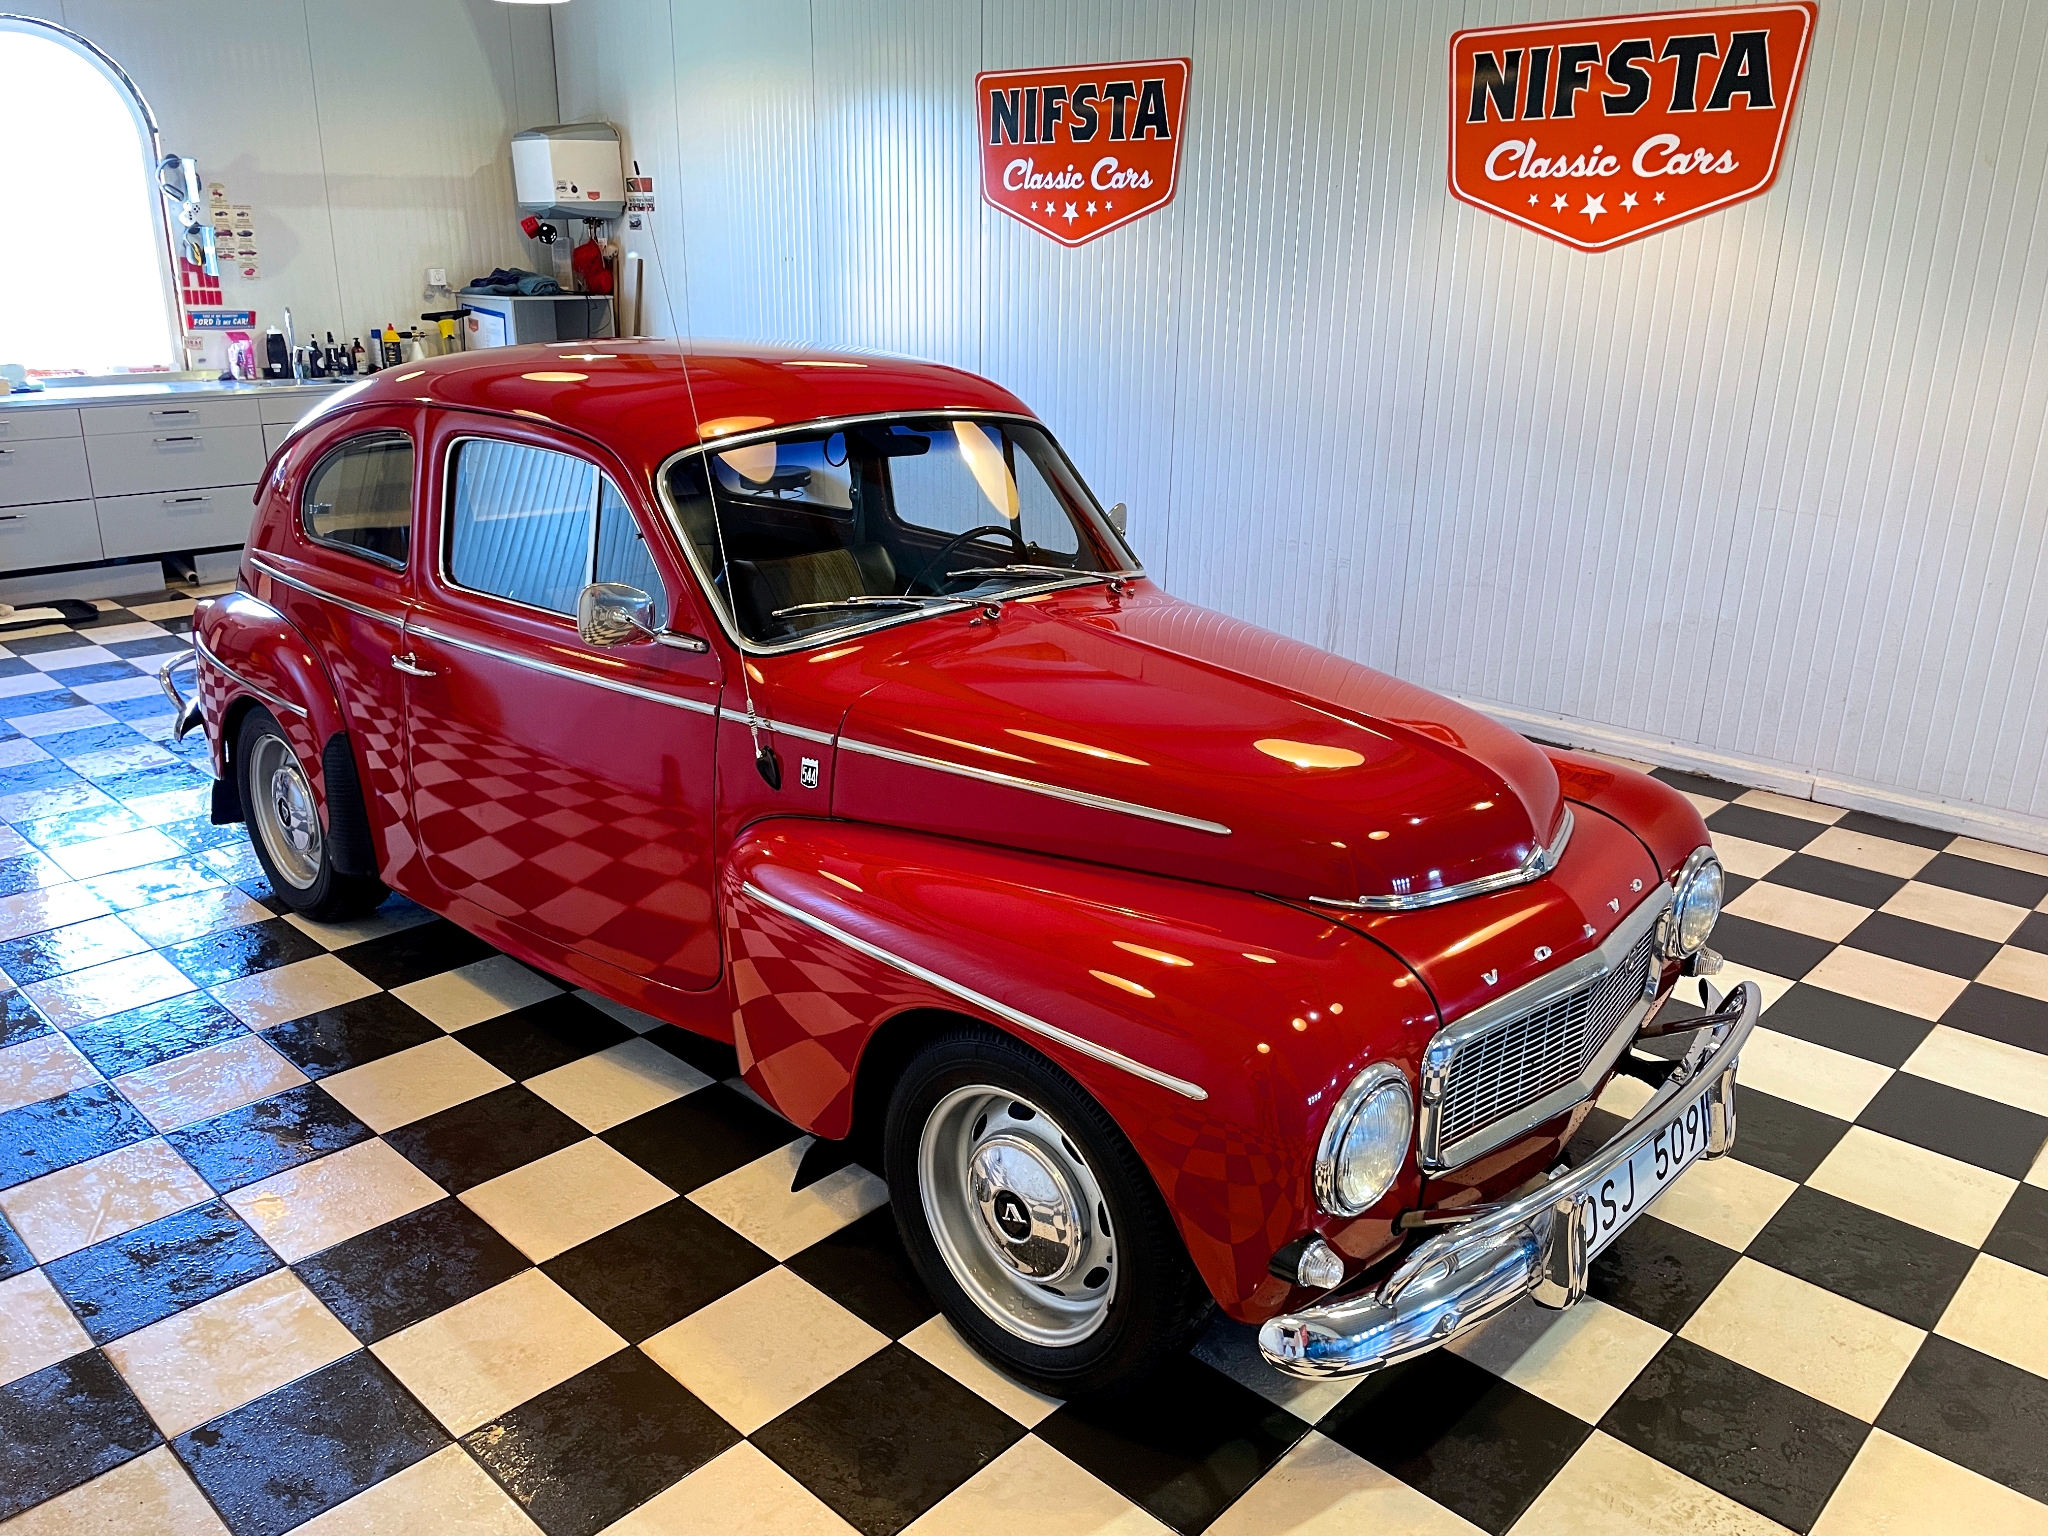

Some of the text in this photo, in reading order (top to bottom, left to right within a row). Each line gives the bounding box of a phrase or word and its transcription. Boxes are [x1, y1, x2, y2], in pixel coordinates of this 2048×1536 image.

[1466, 29, 1777, 124] NIFSTA
[989, 78, 1172, 146] NIFSTA
[1003, 156, 1153, 191] Classic Cars
[1484, 133, 1740, 182] Classic Cars
[193, 318, 214, 326] FORD
[802, 766, 817, 785] 544
[1480, 878, 1643, 986] VOLVO
[1653, 1104, 1699, 1181] 509
